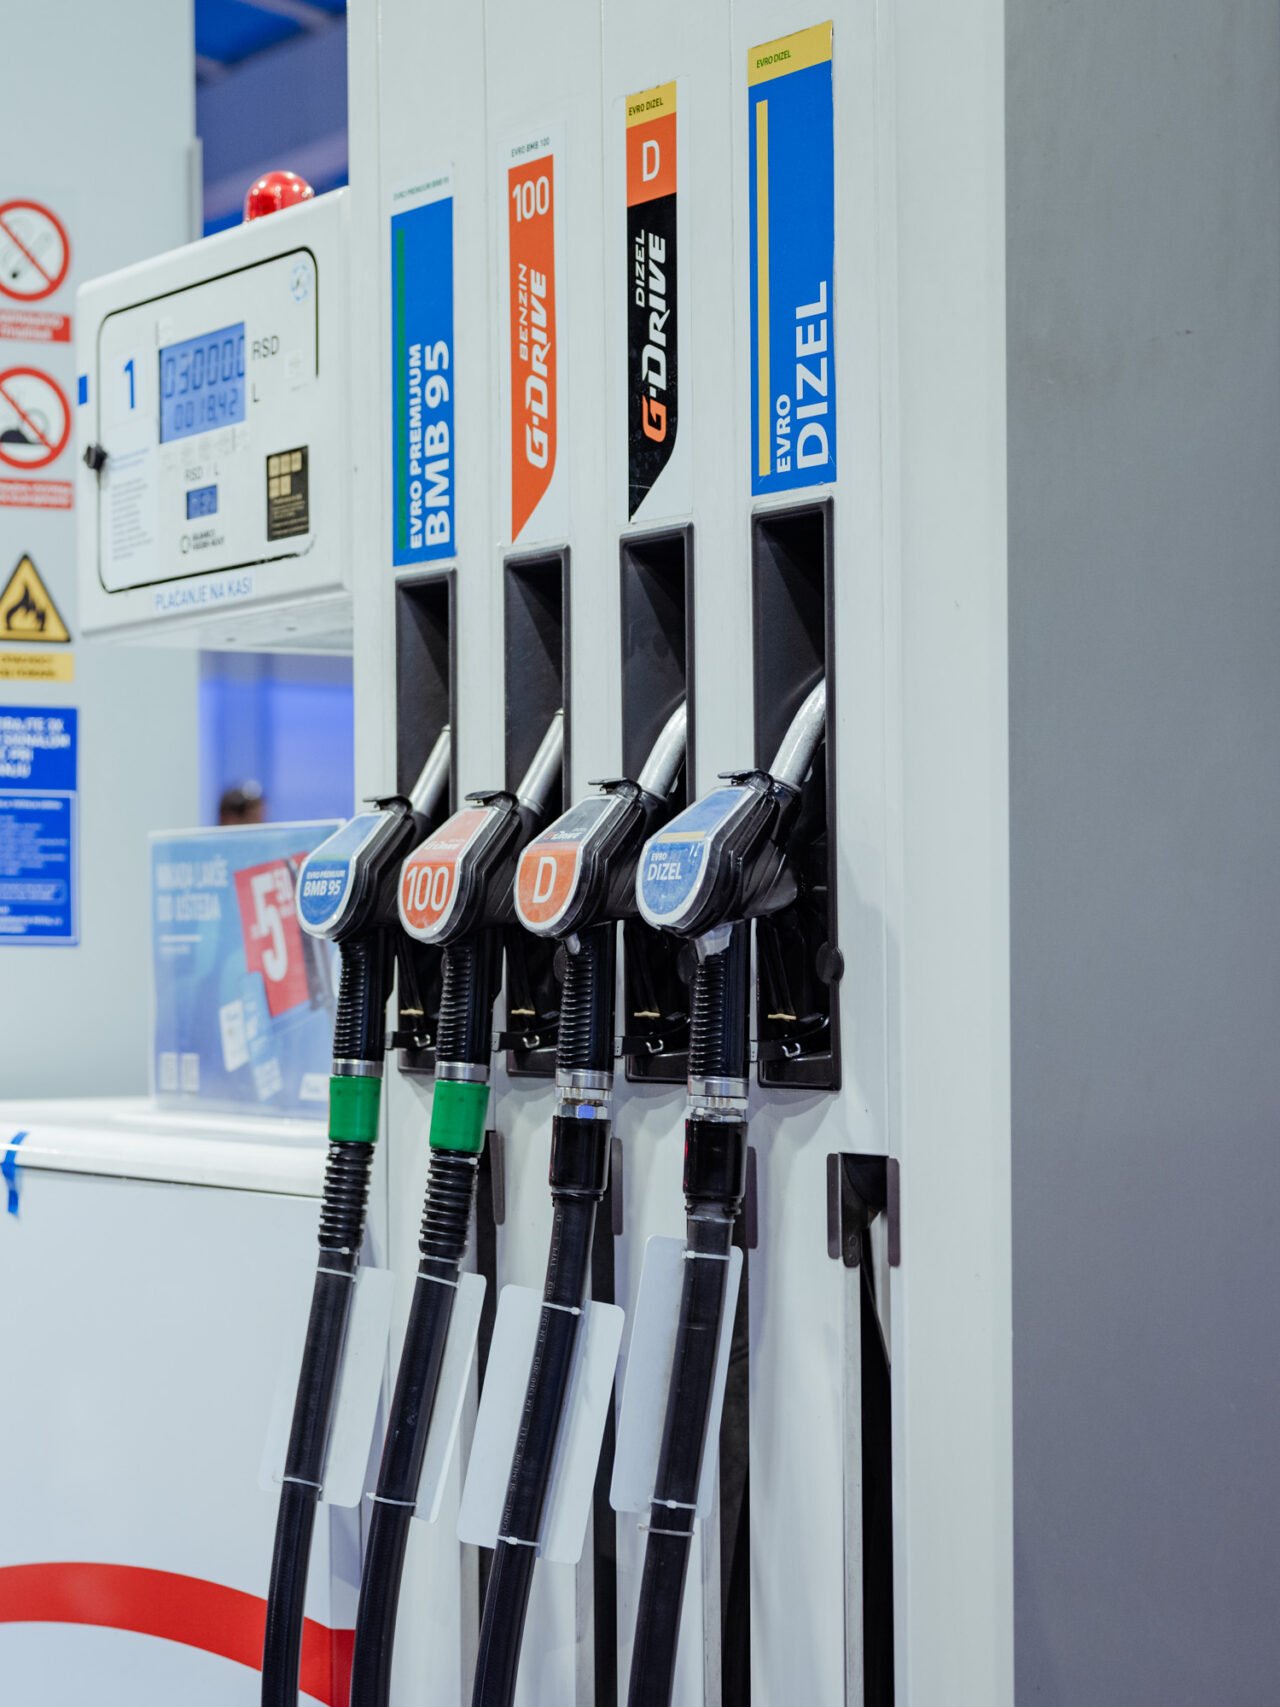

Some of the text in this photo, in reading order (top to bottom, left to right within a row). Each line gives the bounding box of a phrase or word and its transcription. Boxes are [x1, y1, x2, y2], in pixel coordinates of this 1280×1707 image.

[756, 49, 792, 69] EVRO DIZEL
[628, 97, 664, 117] EVRO DIZEL
[641, 139, 661, 183] D
[511, 175, 551, 223] 100
[635, 228, 646, 308] DIZEL
[518, 263, 529, 362] BENZIN
[253, 334, 280, 361] RSD
[124, 359, 135, 409] 1
[795, 280, 829, 470] DIZEL
[408, 343, 423, 549] EVRO PREMIJUM
[424, 340, 451, 547] BMB 95
[775, 394, 792, 474] EVRO
[303, 879, 342, 897] BMB 95
[406, 865, 450, 912] 100
[532, 855, 558, 904] D
[647, 862, 682, 881] DIZEL
